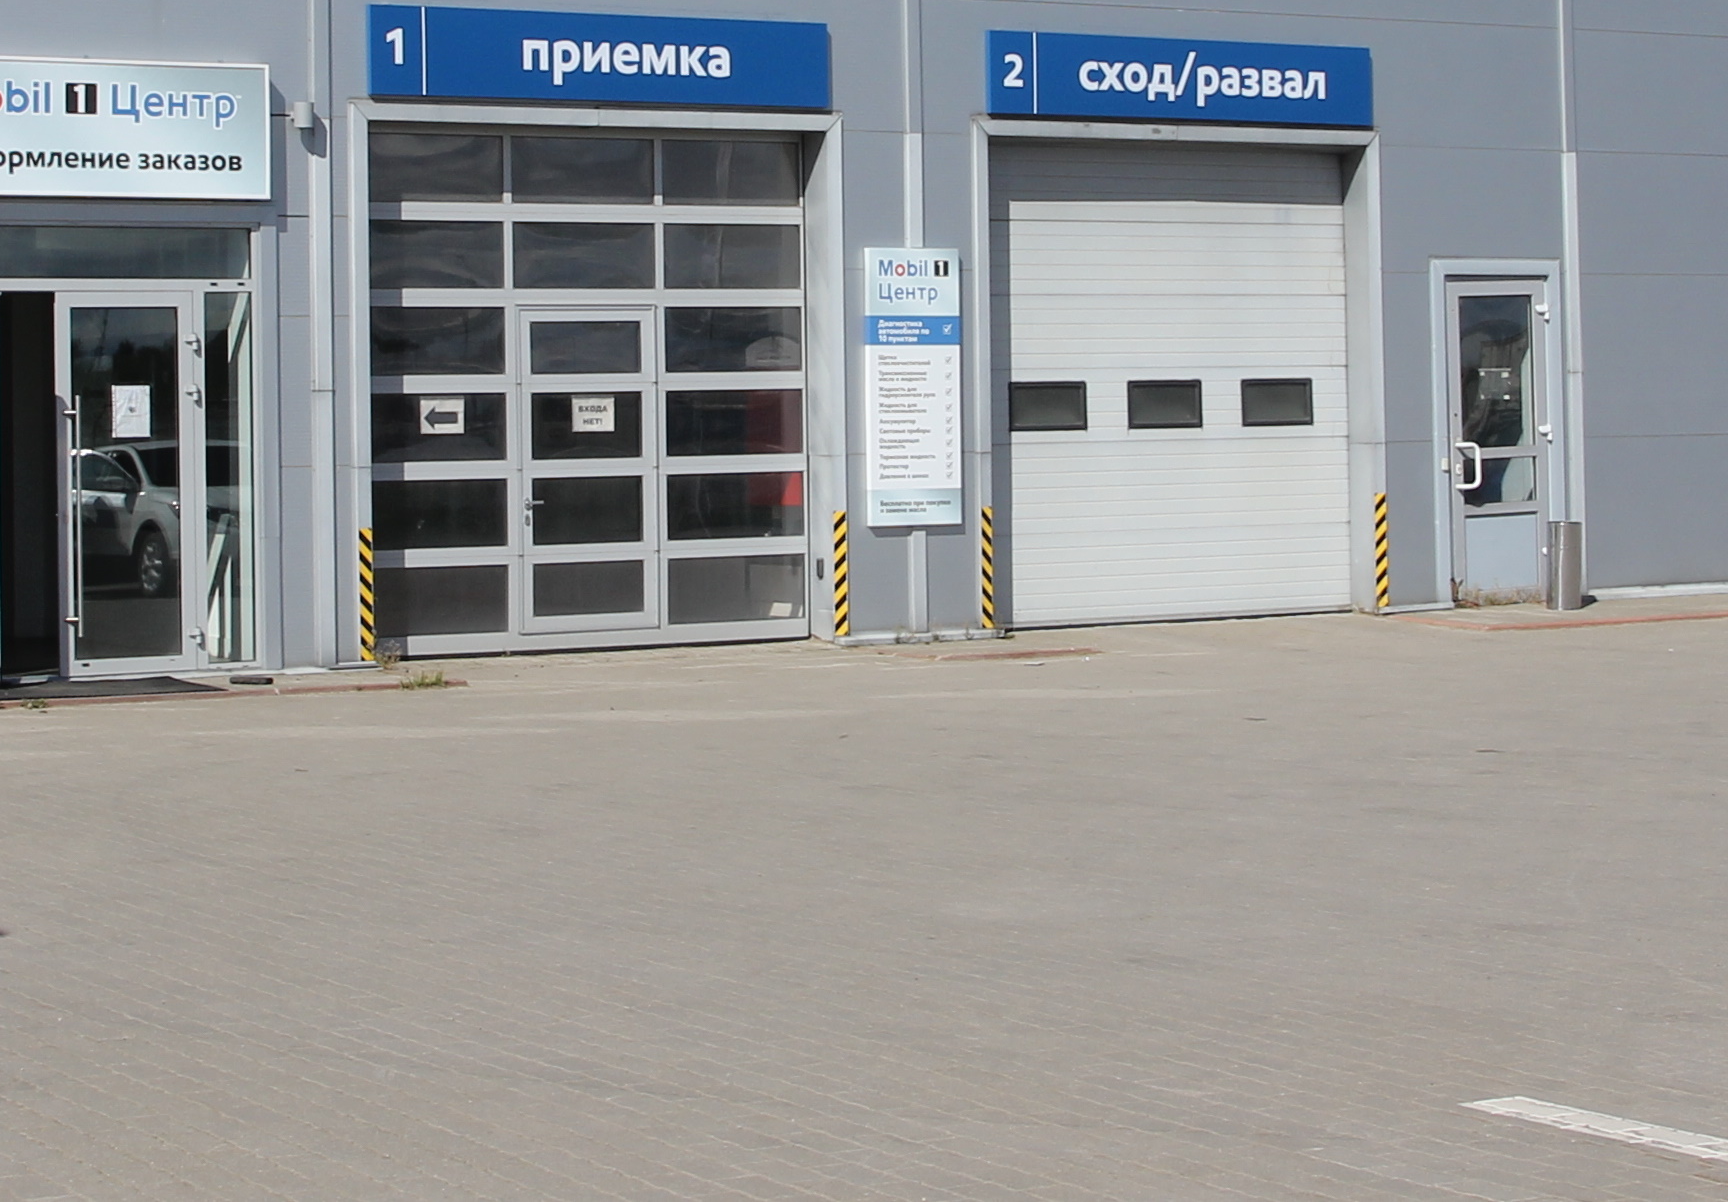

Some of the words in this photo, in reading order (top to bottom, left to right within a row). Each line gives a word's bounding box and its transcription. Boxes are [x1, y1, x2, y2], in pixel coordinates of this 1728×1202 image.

[384, 28, 406, 65] 1
[521, 37, 732, 86] приемка
[1003, 54, 1025, 88] 2
[1077, 51, 1328, 108] сход/развал
[110, 84, 238, 129] Центр
[137, 153, 243, 172] заказов
[878, 259, 928, 277] Mobil
[878, 283, 938, 305] Центр
[578, 405, 608, 414] ВХОДА
